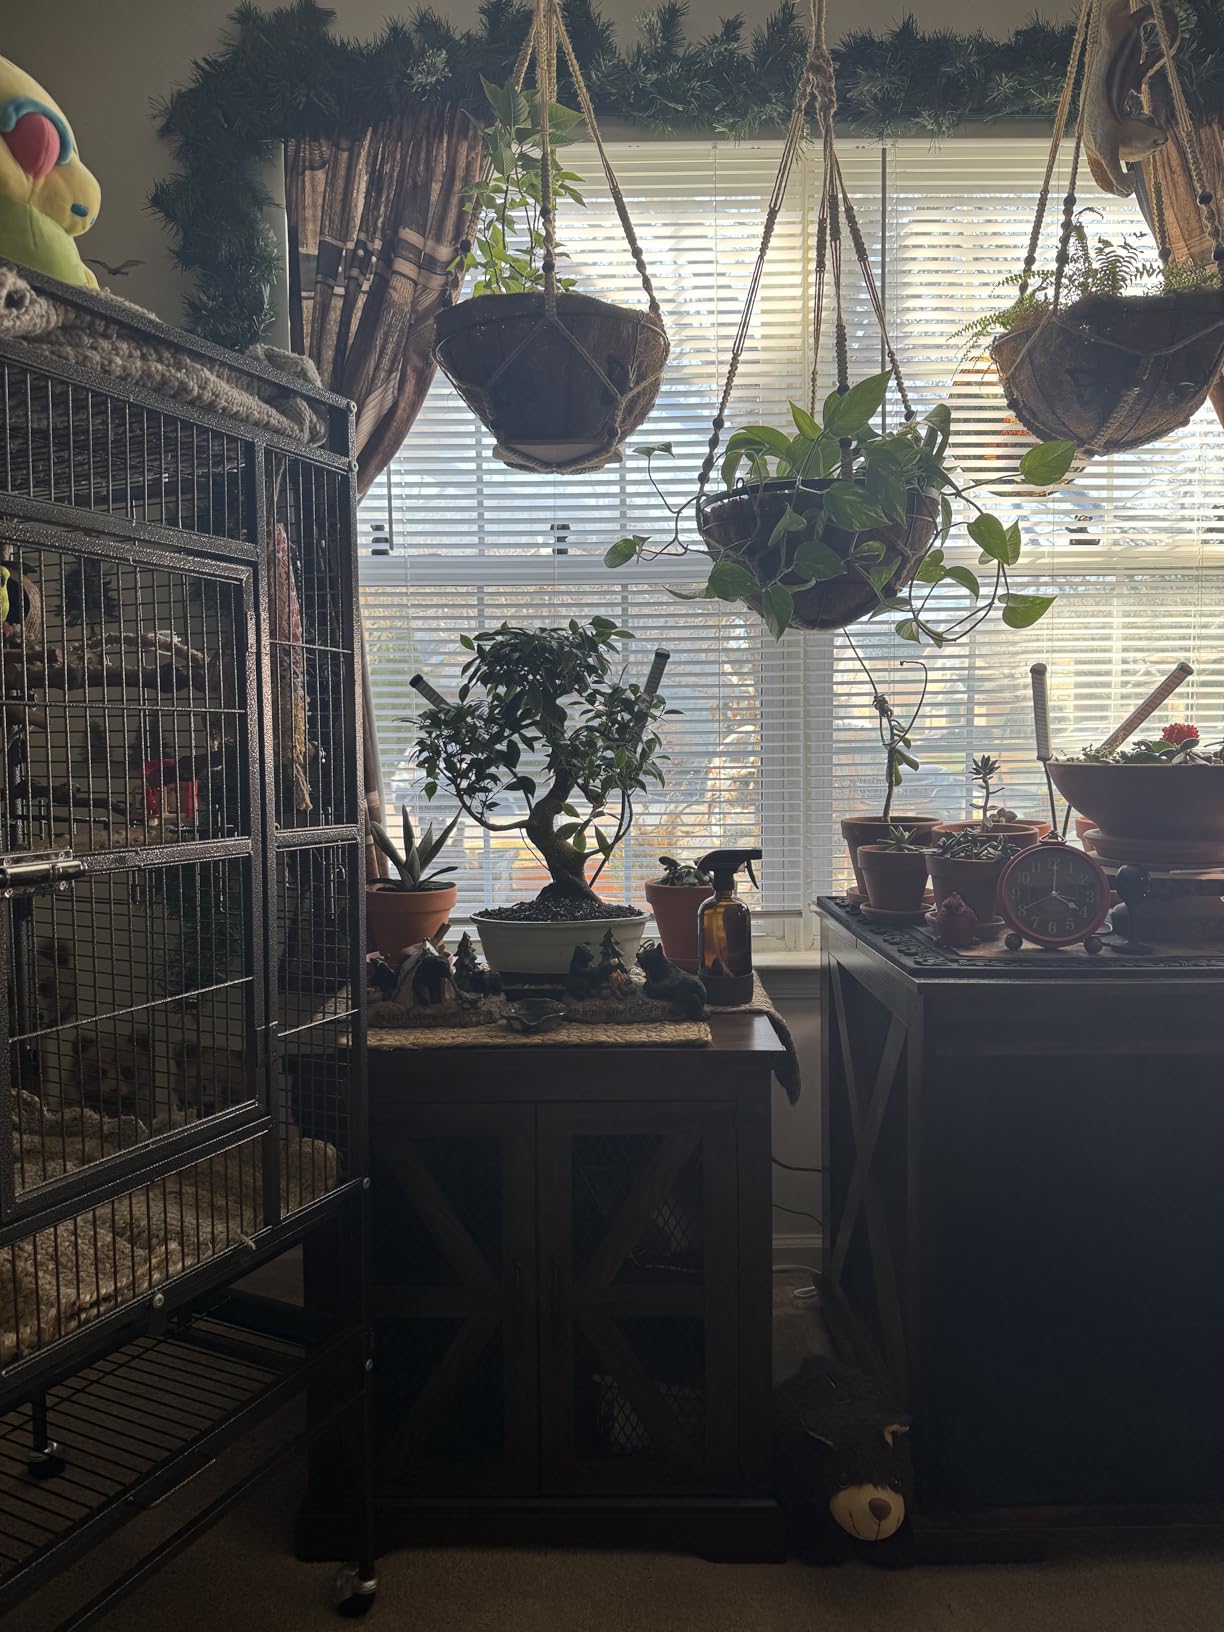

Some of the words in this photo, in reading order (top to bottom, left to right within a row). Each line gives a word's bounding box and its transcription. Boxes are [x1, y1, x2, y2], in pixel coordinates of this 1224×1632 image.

[1031, 861, 1041, 873] 11
[1047, 857, 1061, 870] 12
[1067, 861, 1073, 874] 1
[1016, 872, 1030, 885] 10
[1079, 872, 1089, 886] 2
[1010, 888, 1020, 901] 9
[1085, 889, 1096, 904] 3
[1017, 904, 1027, 917] 8
[1079, 905, 1088, 918] 4
[1031, 916, 1041, 929] 7
[1048, 920, 1057, 935] 6
[1065, 918, 1076, 931] 5
